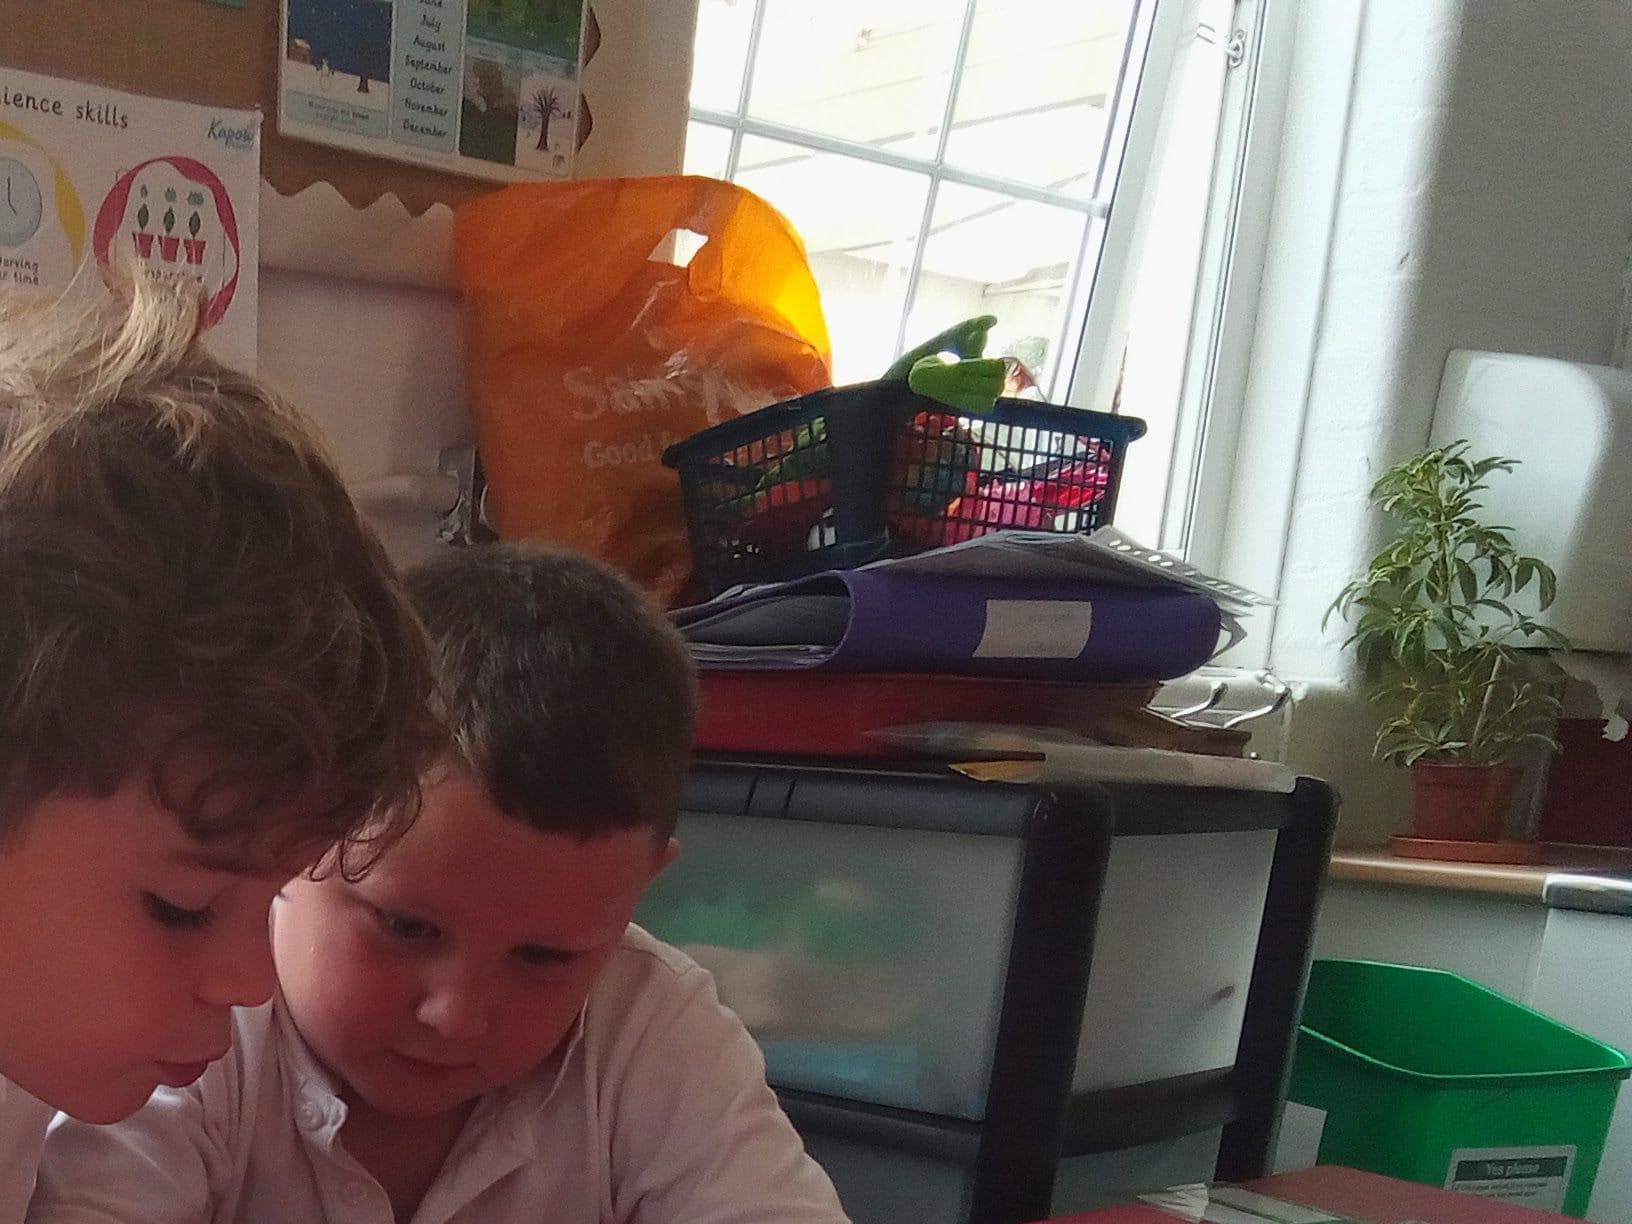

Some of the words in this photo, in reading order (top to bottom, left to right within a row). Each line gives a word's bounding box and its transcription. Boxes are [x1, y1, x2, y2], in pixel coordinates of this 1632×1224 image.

[420, 14, 441, 32] July
[413, 35, 445, 52] August
[405, 55, 452, 74] September
[410, 77, 445, 94] October
[76, 100, 128, 129] skills
[403, 98, 448, 116] November
[403, 119, 448, 136] December
